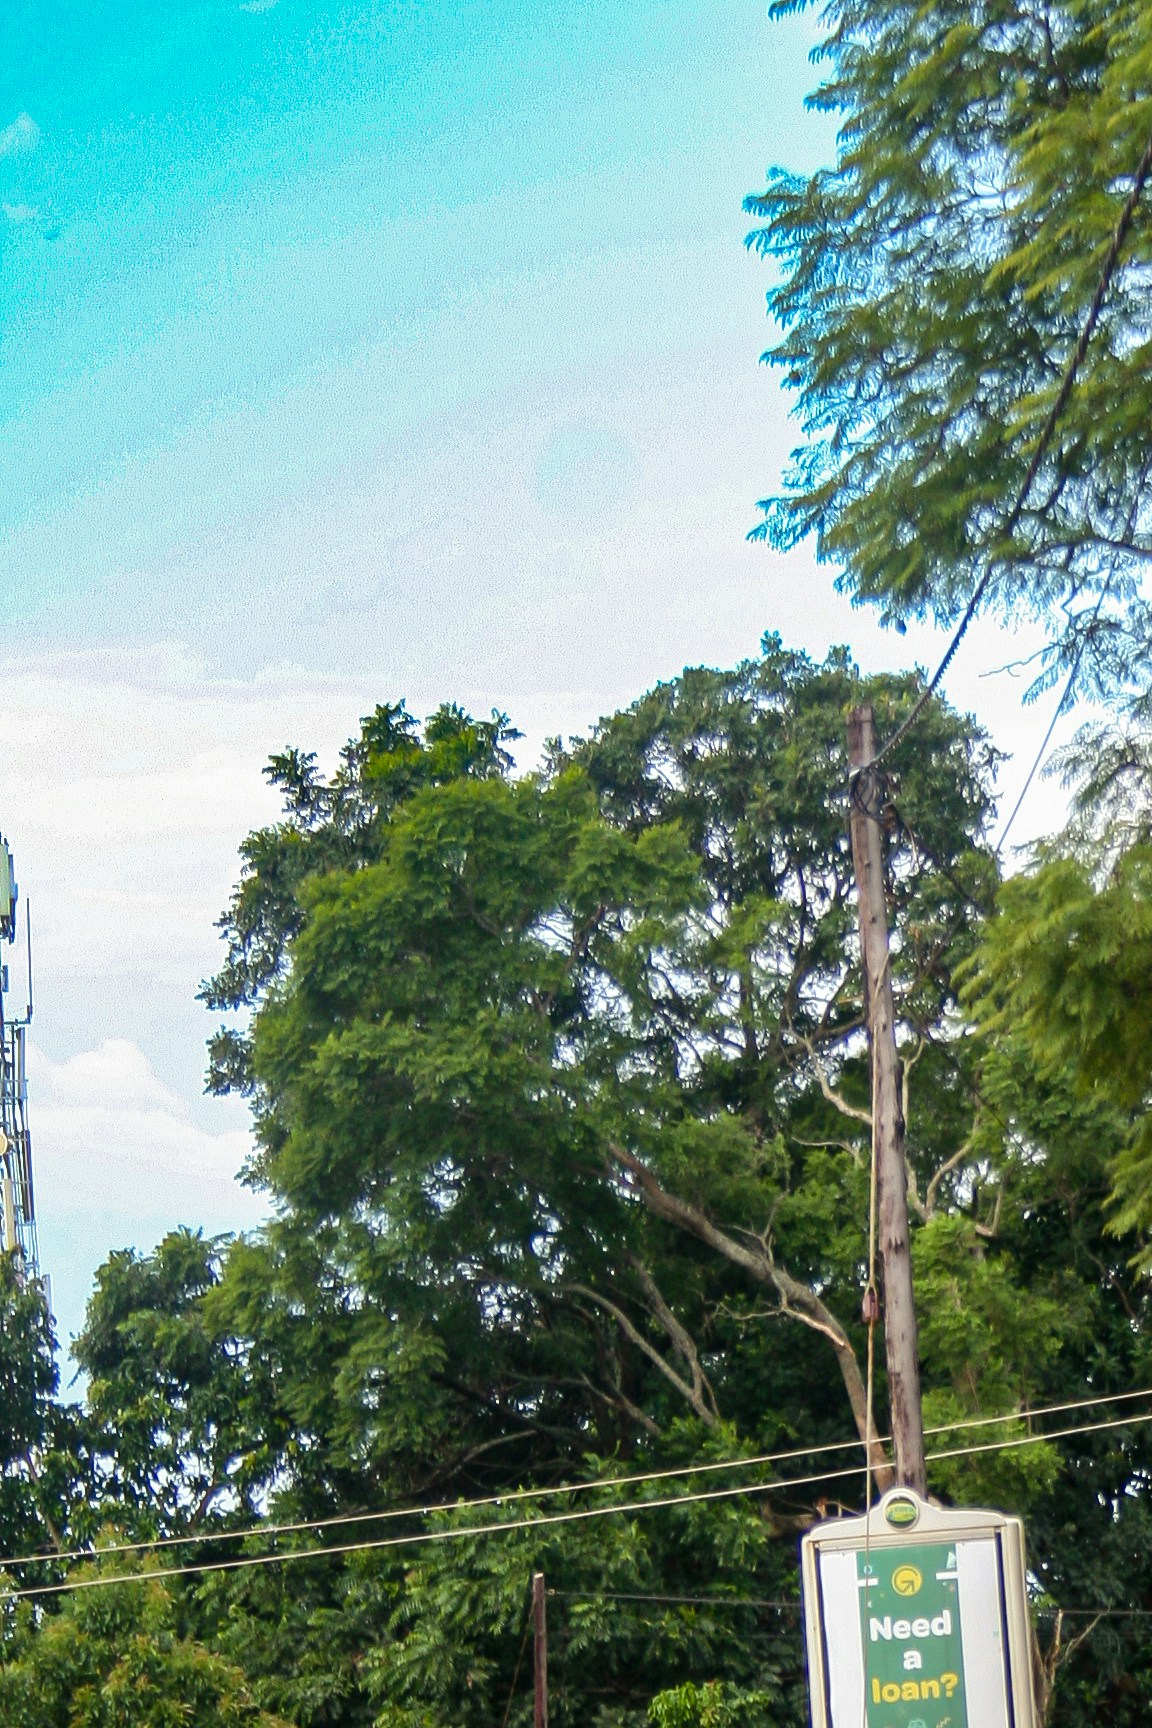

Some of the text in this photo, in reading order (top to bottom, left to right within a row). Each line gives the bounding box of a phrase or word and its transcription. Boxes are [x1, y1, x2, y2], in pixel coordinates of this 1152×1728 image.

[869, 1610, 952, 1642] Need
[903, 1650, 923, 1671] a
[871, 1673, 959, 1706] loan?
